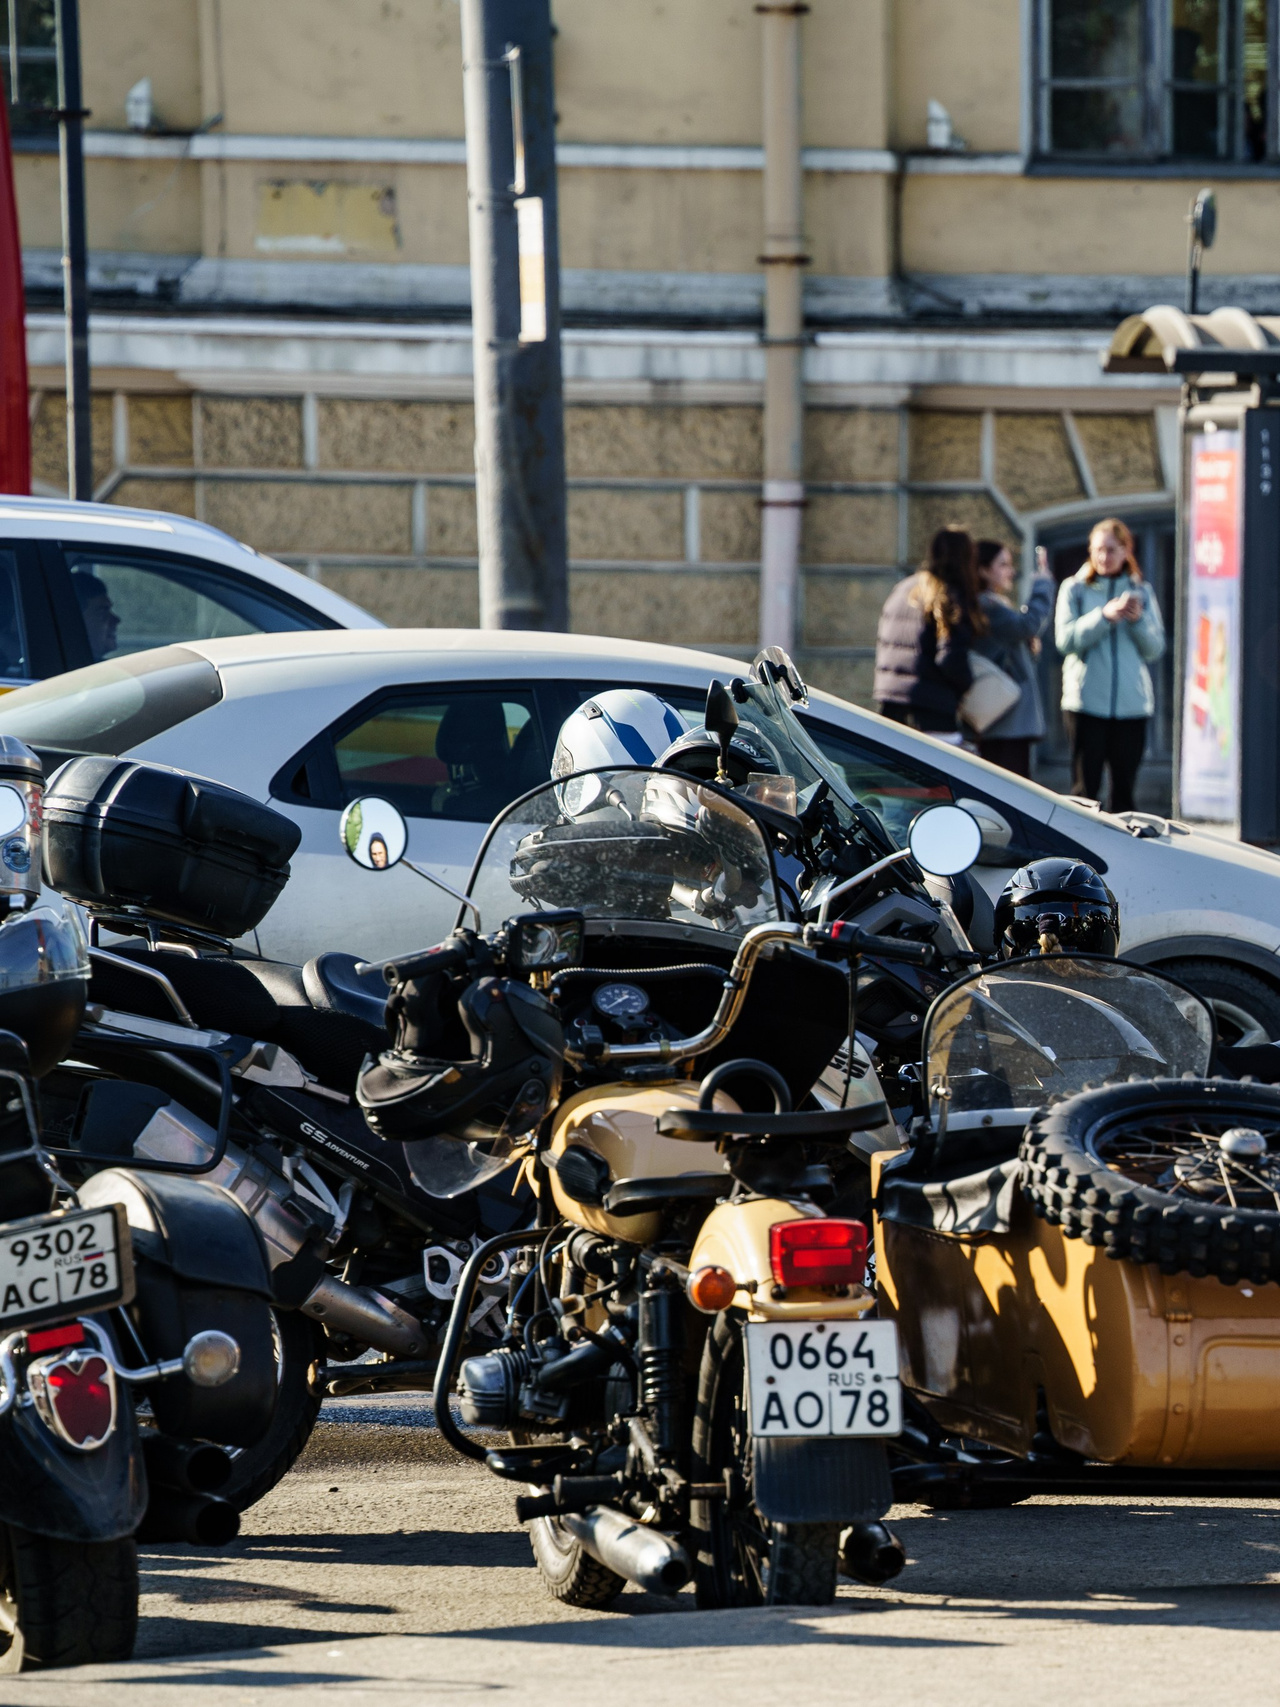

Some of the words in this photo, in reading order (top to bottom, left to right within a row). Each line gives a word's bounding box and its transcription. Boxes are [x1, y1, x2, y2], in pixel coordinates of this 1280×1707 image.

[300, 1121, 328, 1145] GS
[325, 1141, 370, 1171] ADVENTURE
[10, 1223, 97, 1267] 9302
[54, 1253, 83, 1268] RUS
[1, 1276, 49, 1313] AC
[66, 1262, 109, 1296] 78
[770, 1331, 875, 1370] 0664
[828, 1372, 866, 1387] RUS
[760, 1391, 824, 1430] AO
[840, 1390, 890, 1428] 78
